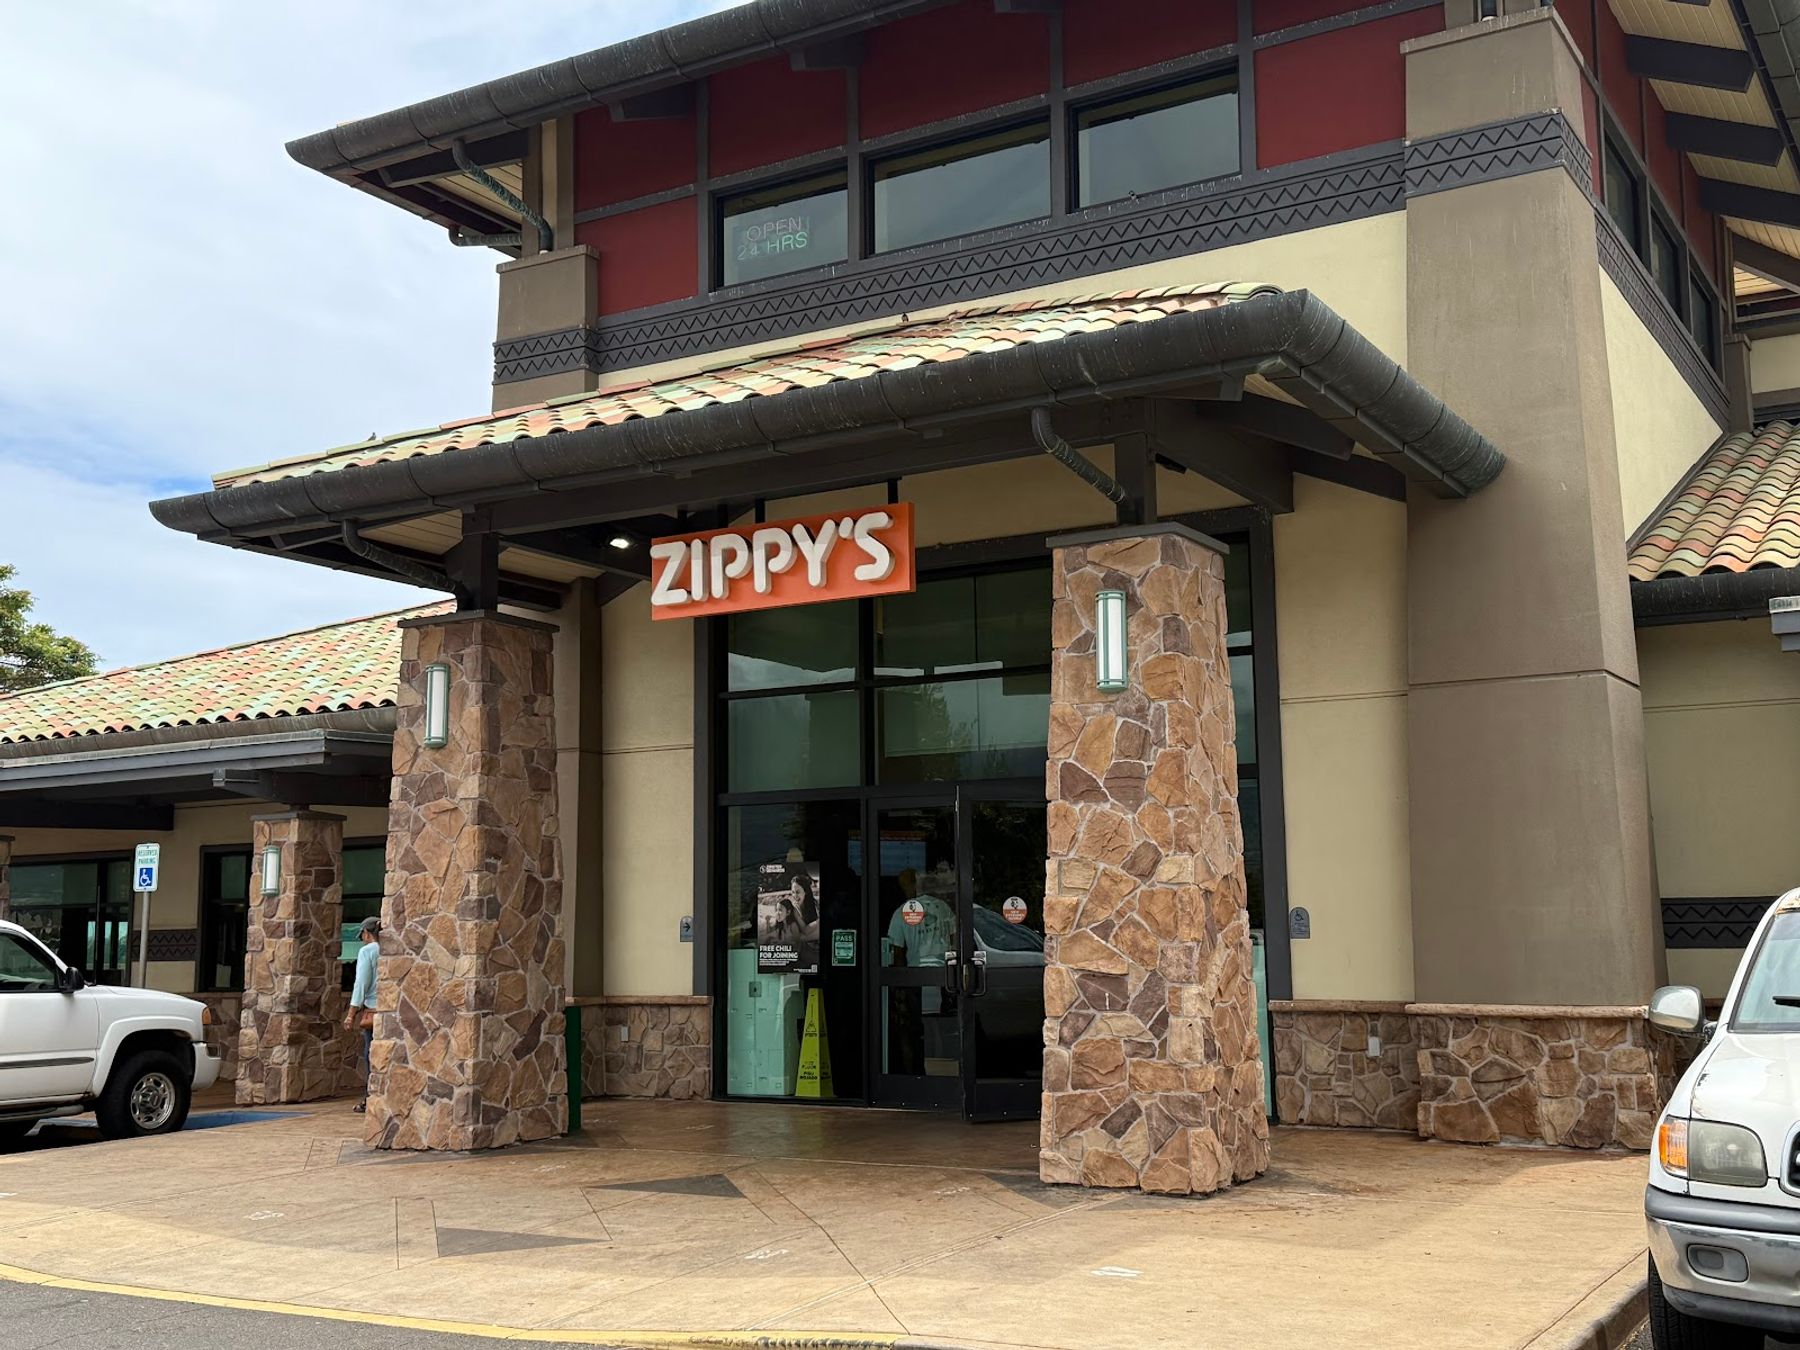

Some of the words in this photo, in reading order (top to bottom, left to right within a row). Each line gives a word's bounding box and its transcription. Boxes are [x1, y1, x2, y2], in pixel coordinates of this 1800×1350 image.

[746, 217, 802, 242] OPEN
[737, 244, 759, 260] 24
[767, 231, 808, 254] HRS
[650, 512, 894, 606] ZIPPY'S
[759, 951, 772, 959] FOR
[772, 951, 799, 959] JOINING
